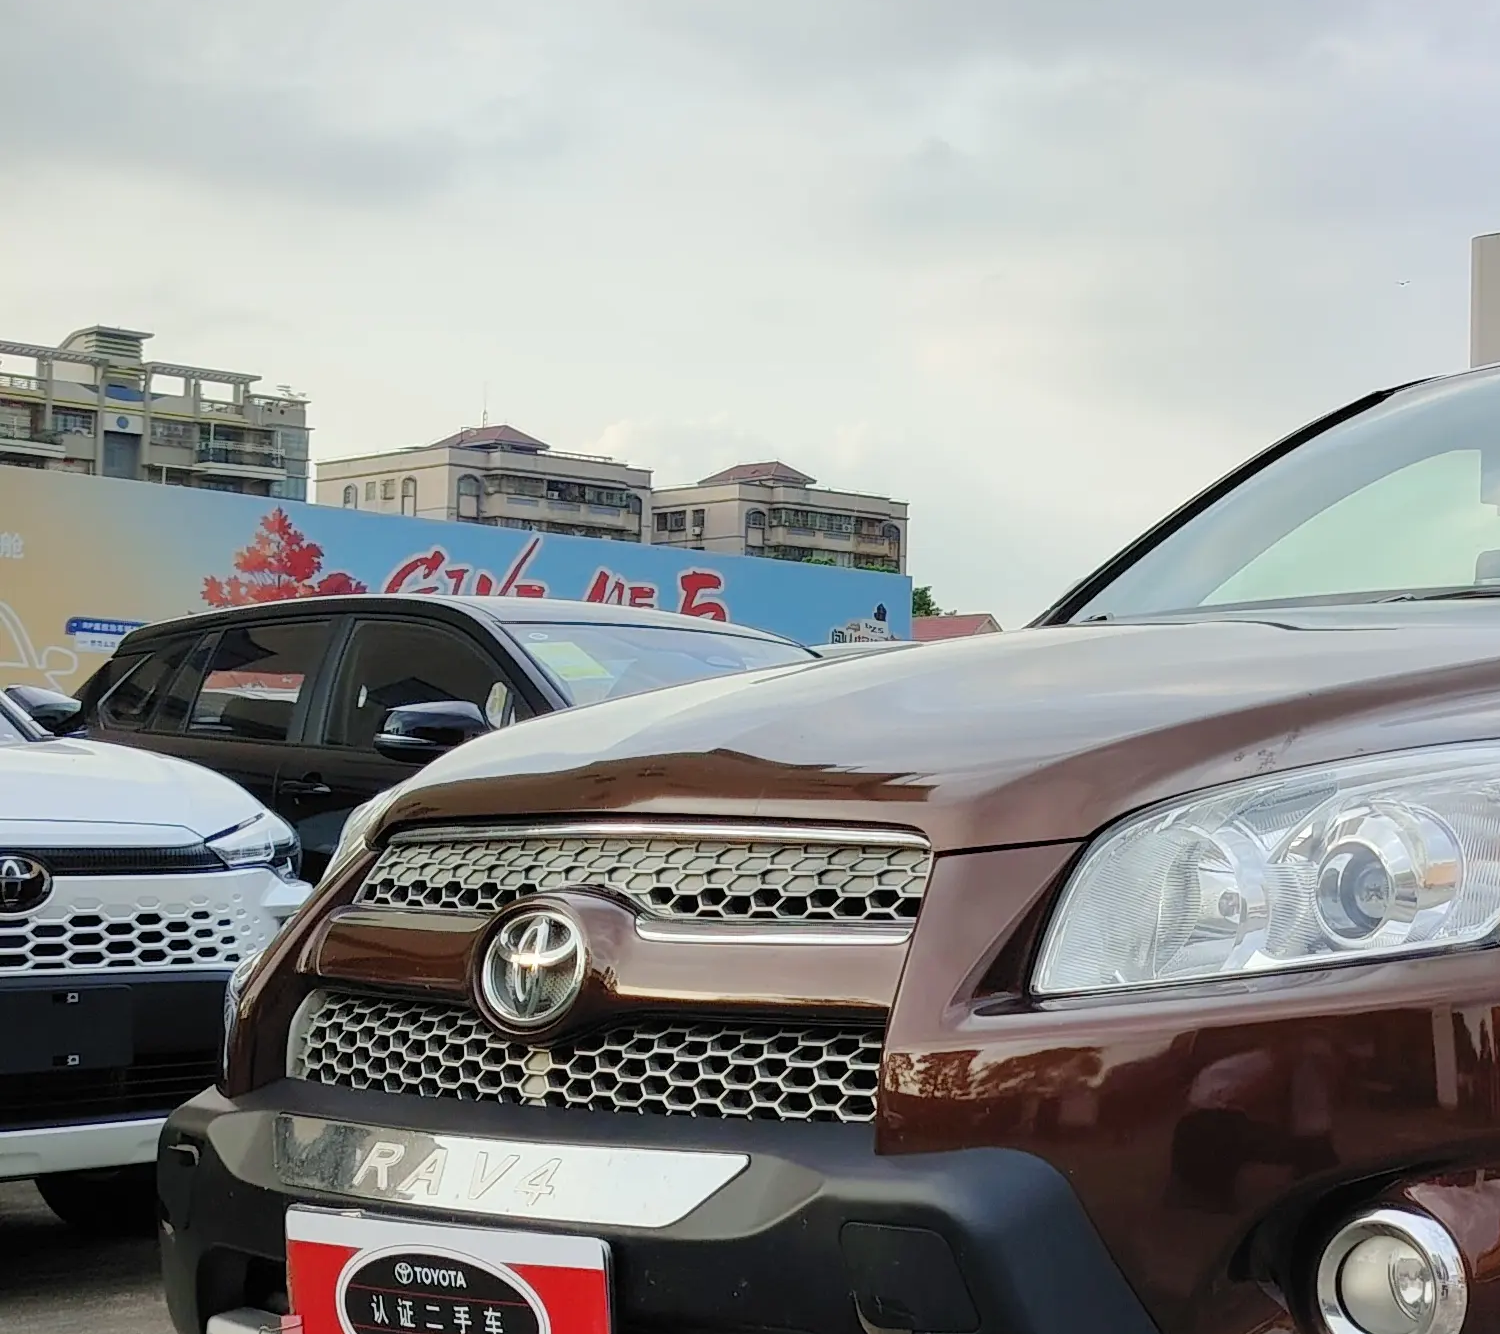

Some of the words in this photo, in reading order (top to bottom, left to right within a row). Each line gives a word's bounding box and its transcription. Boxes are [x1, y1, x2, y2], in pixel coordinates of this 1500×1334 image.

[681, 570, 727, 623] 5
[352, 1141, 563, 1207] RAV4
[414, 1266, 468, 1290] TOYOTA
